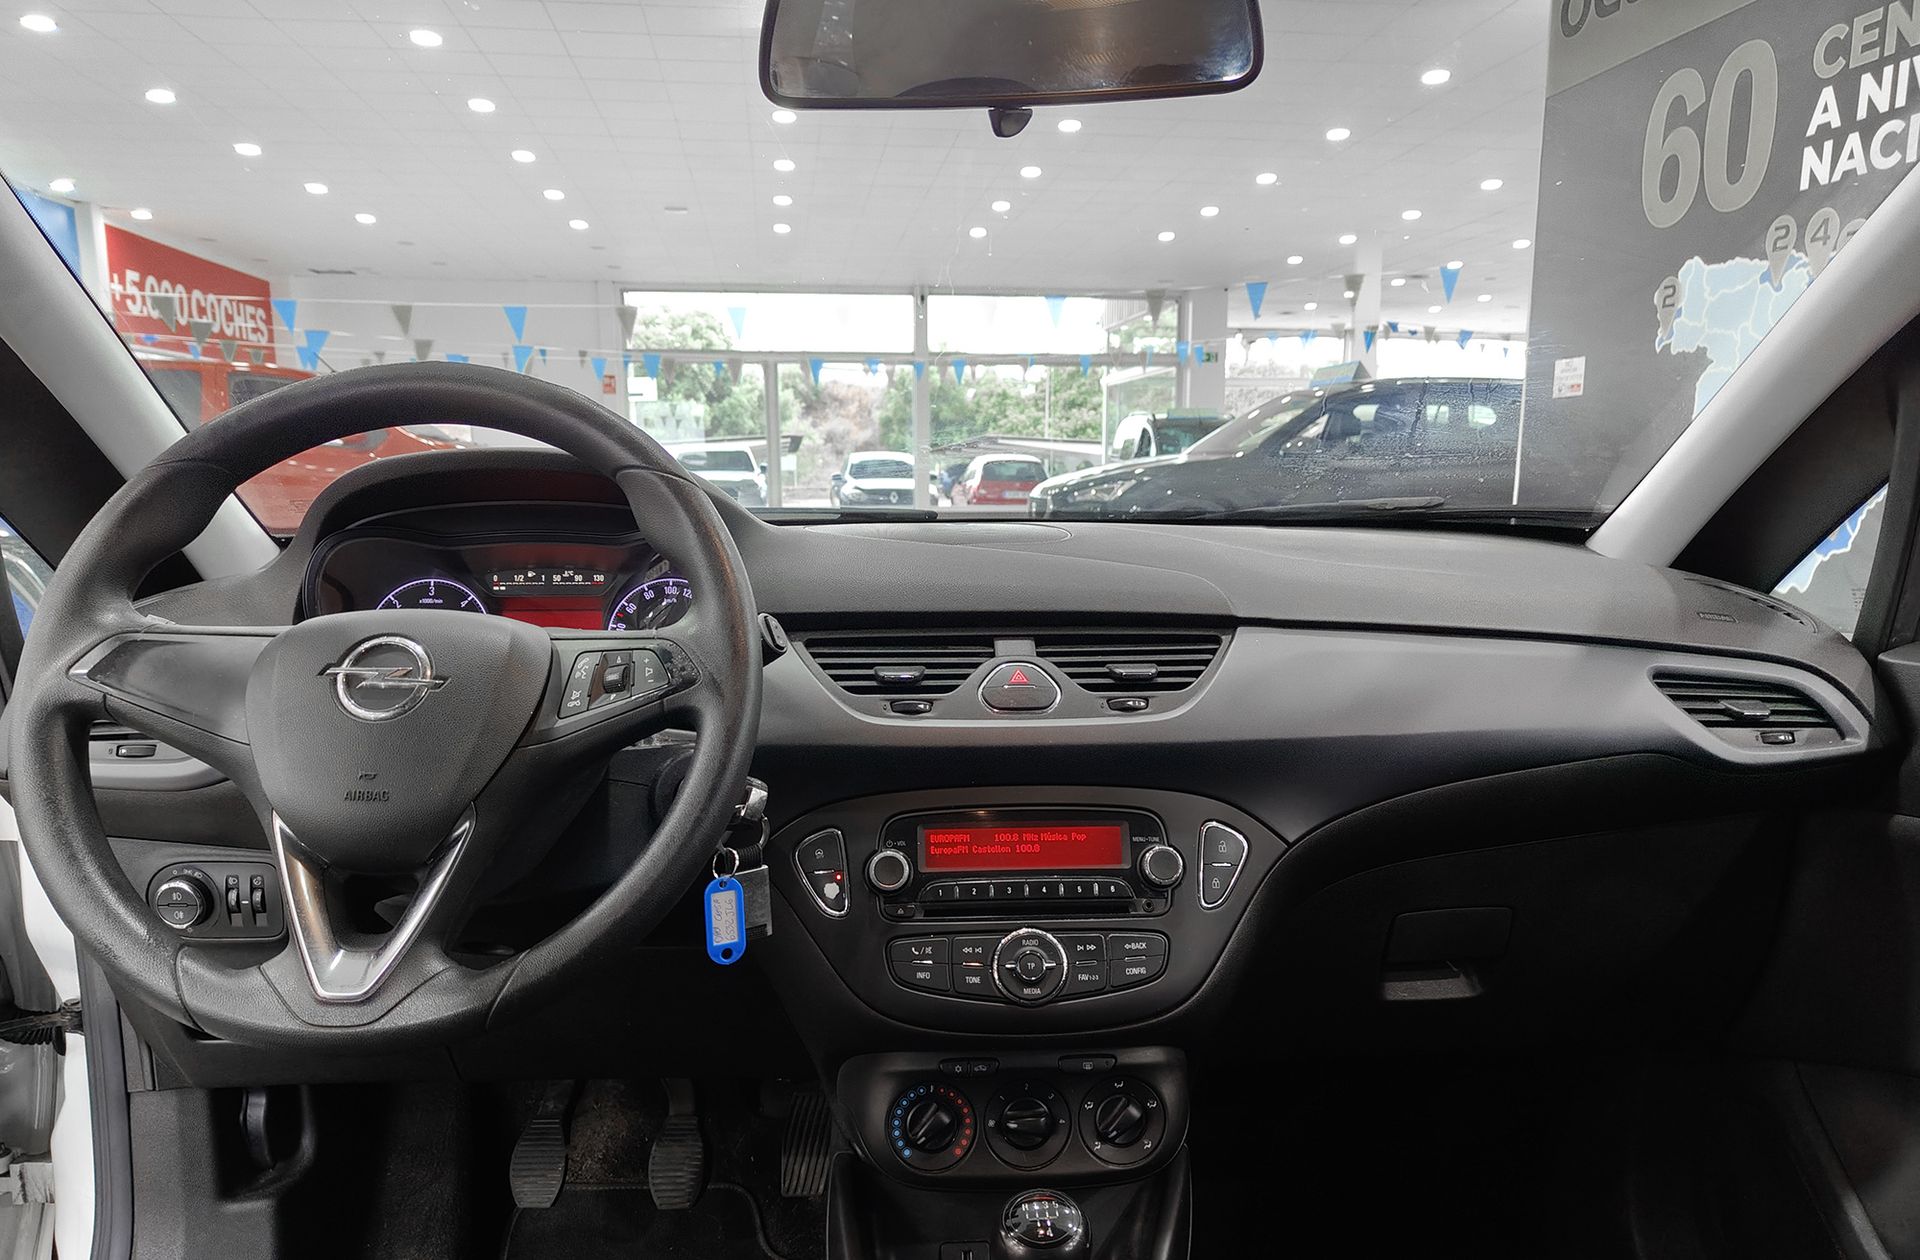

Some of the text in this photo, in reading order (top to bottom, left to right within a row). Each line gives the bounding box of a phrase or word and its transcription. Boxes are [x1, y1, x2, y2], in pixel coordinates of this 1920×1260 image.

[1813, 0, 1920, 79] CEN
[1805, 55, 1920, 137] A NI
[1642, 39, 1778, 229] 60
[1800, 112, 1920, 191] NACI
[1810, 217, 1831, 246] 4
[1772, 223, 1791, 253] 2
[1662, 284, 1676, 309] 2
[191, 289, 269, 345] COCHES
[493, 574, 498, 582] 0
[552, 574, 605, 582] 50 90 130
[428, 586, 435, 596] 3
[643, 590, 655, 600] 80
[663, 586, 678, 595] 100
[392, 600, 402, 609] 2
[460, 599, 469, 608] 4
[625, 602, 637, 614] 60
[344, 790, 390, 802] AIRBAG
[930, 834, 970, 843] EUROPAFM
[994, 833, 1019, 842] 100.8
[1071, 831, 1087, 842] Pop
[930, 845, 969, 855] EuropaFM
[1015, 843, 1040, 853] 100.8
[939, 889, 943, 897] 1
[1007, 886, 1012, 894] 3
[1077, 885, 1082, 893] 5
[1110, 885, 1115, 893] 6
[1027, 962, 1036, 970] TP
[1125, 967, 1147, 975] CONFIG
[965, 976, 981, 984] TONE
